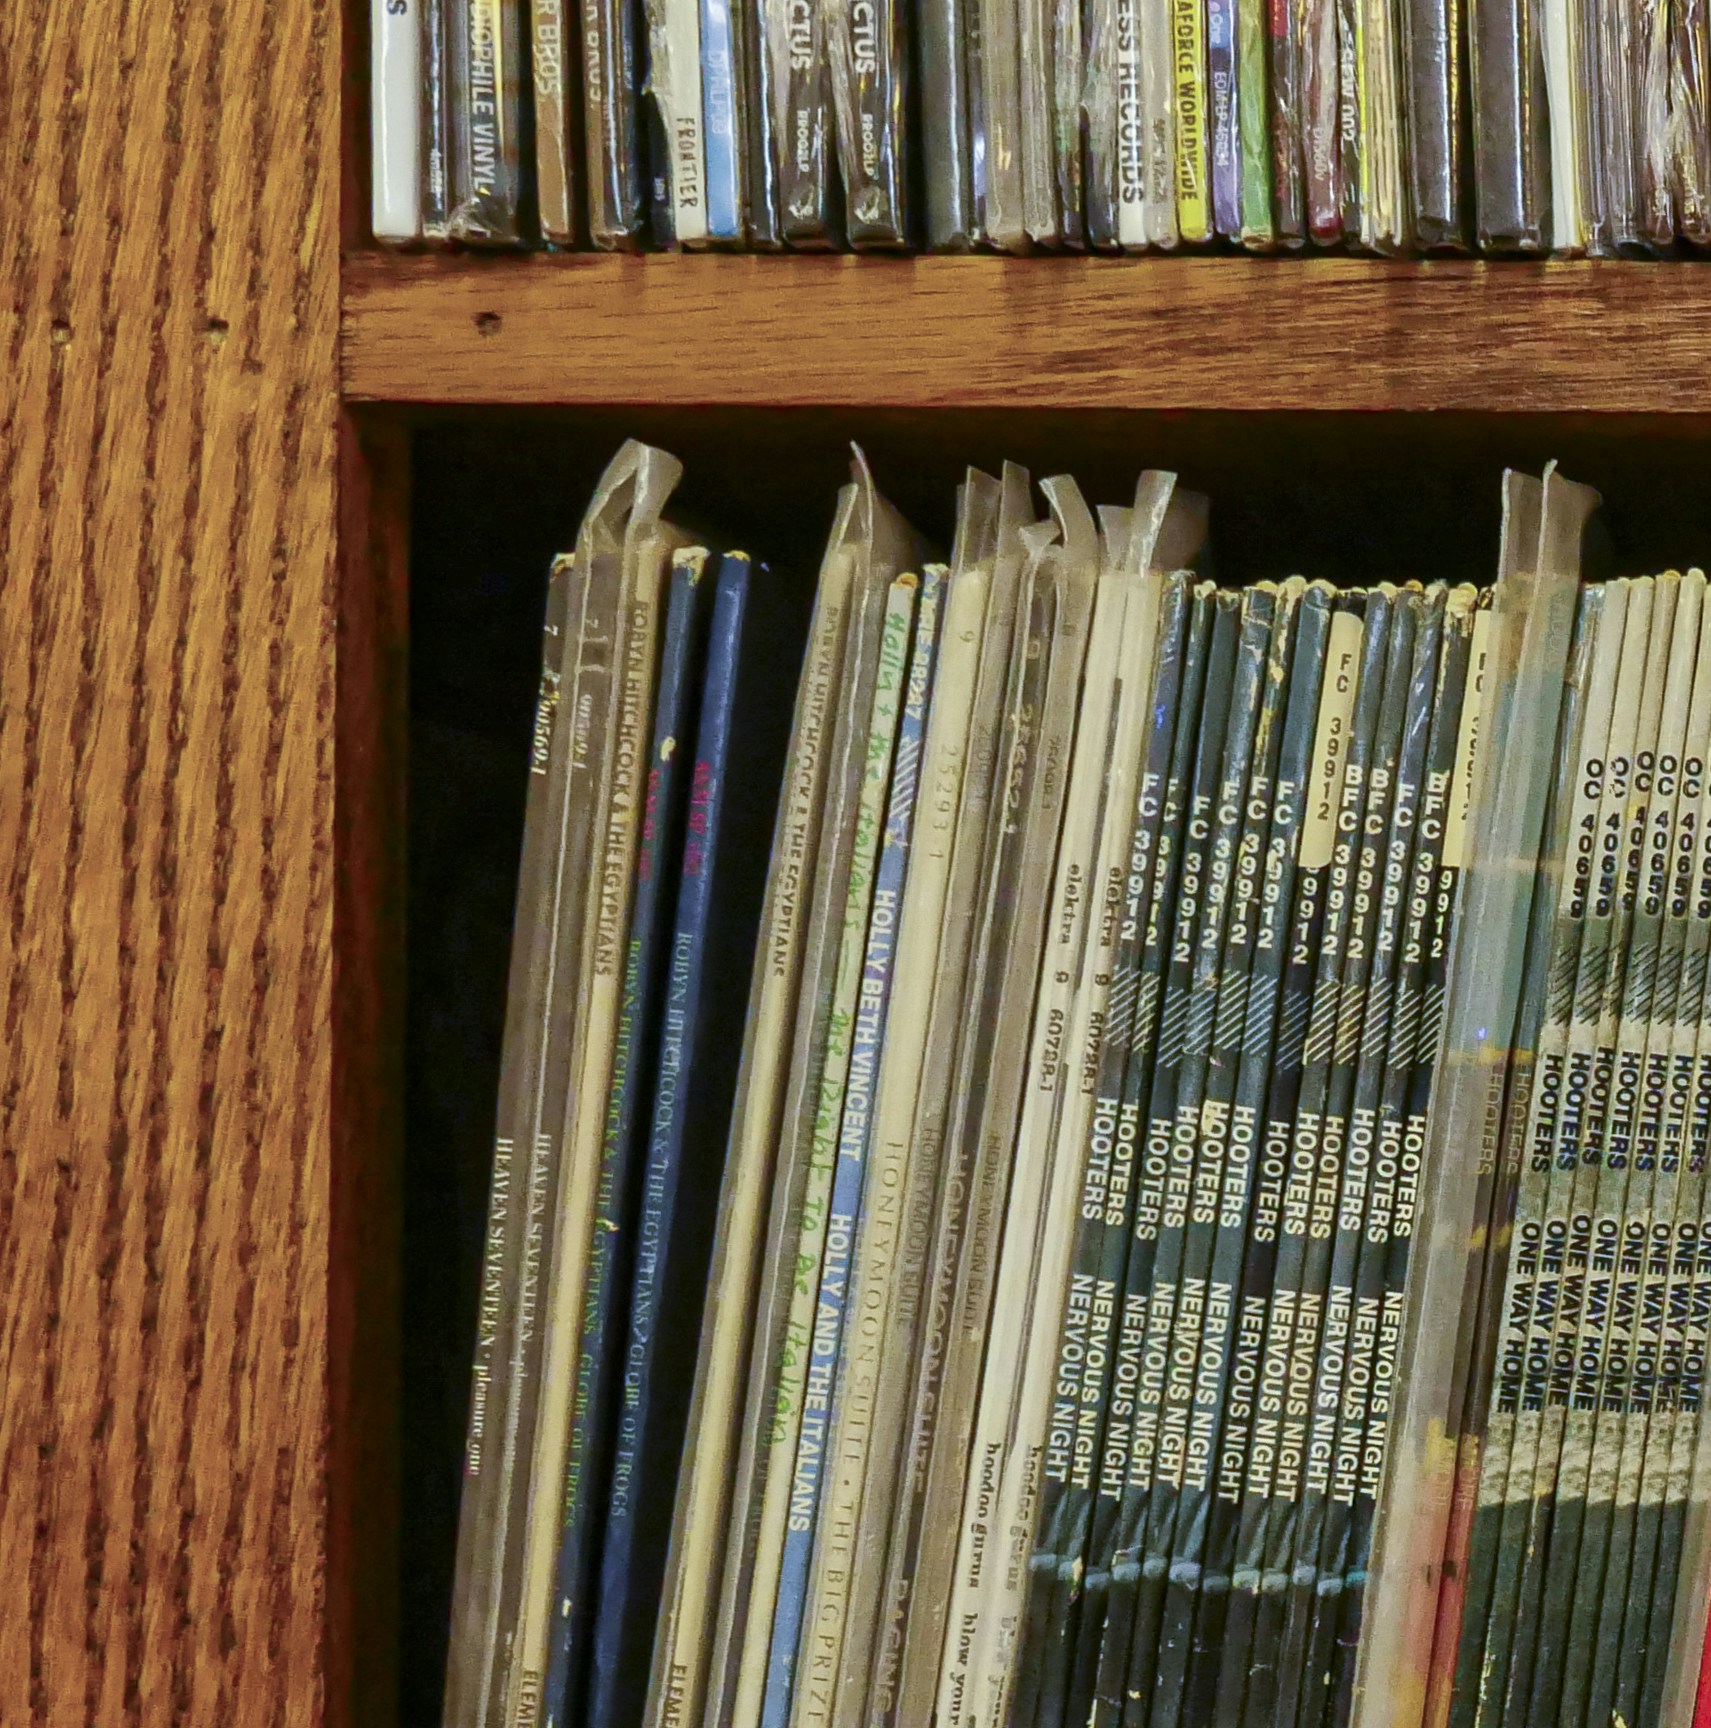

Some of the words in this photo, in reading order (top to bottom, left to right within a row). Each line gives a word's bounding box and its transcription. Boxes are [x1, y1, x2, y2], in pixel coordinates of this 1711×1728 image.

[673, 116, 699, 208] FRONTIER
[1118, 63, 1142, 204] RECORDS
[1177, 81, 1198, 199] WORLDWIDE
[1188, 795, 1209, 839] FC
[864, 888, 894, 973] HOLLY
[1173, 851, 1202, 962] 39912
[855, 979, 882, 1044] BETH
[840, 1049, 873, 1160] VINCENT
[1606, 1049, 1641, 1170] HOOTERS
[1082, 1096, 1116, 1220] HOOTERS
[820, 1213, 851, 1297] HOLLY
[1591, 1218, 1619, 1272] ONE
[812, 1303, 838, 1356] AND
[1055, 1272, 1094, 1397] NERVOUS
[1582, 1277, 1610, 1330] WAY
[804, 1362, 830, 1410] THE
[1570, 1335, 1602, 1411] HOME
[787, 1416, 823, 1532] ITALIANS
[1044, 1401, 1076, 1482] NIGHT
